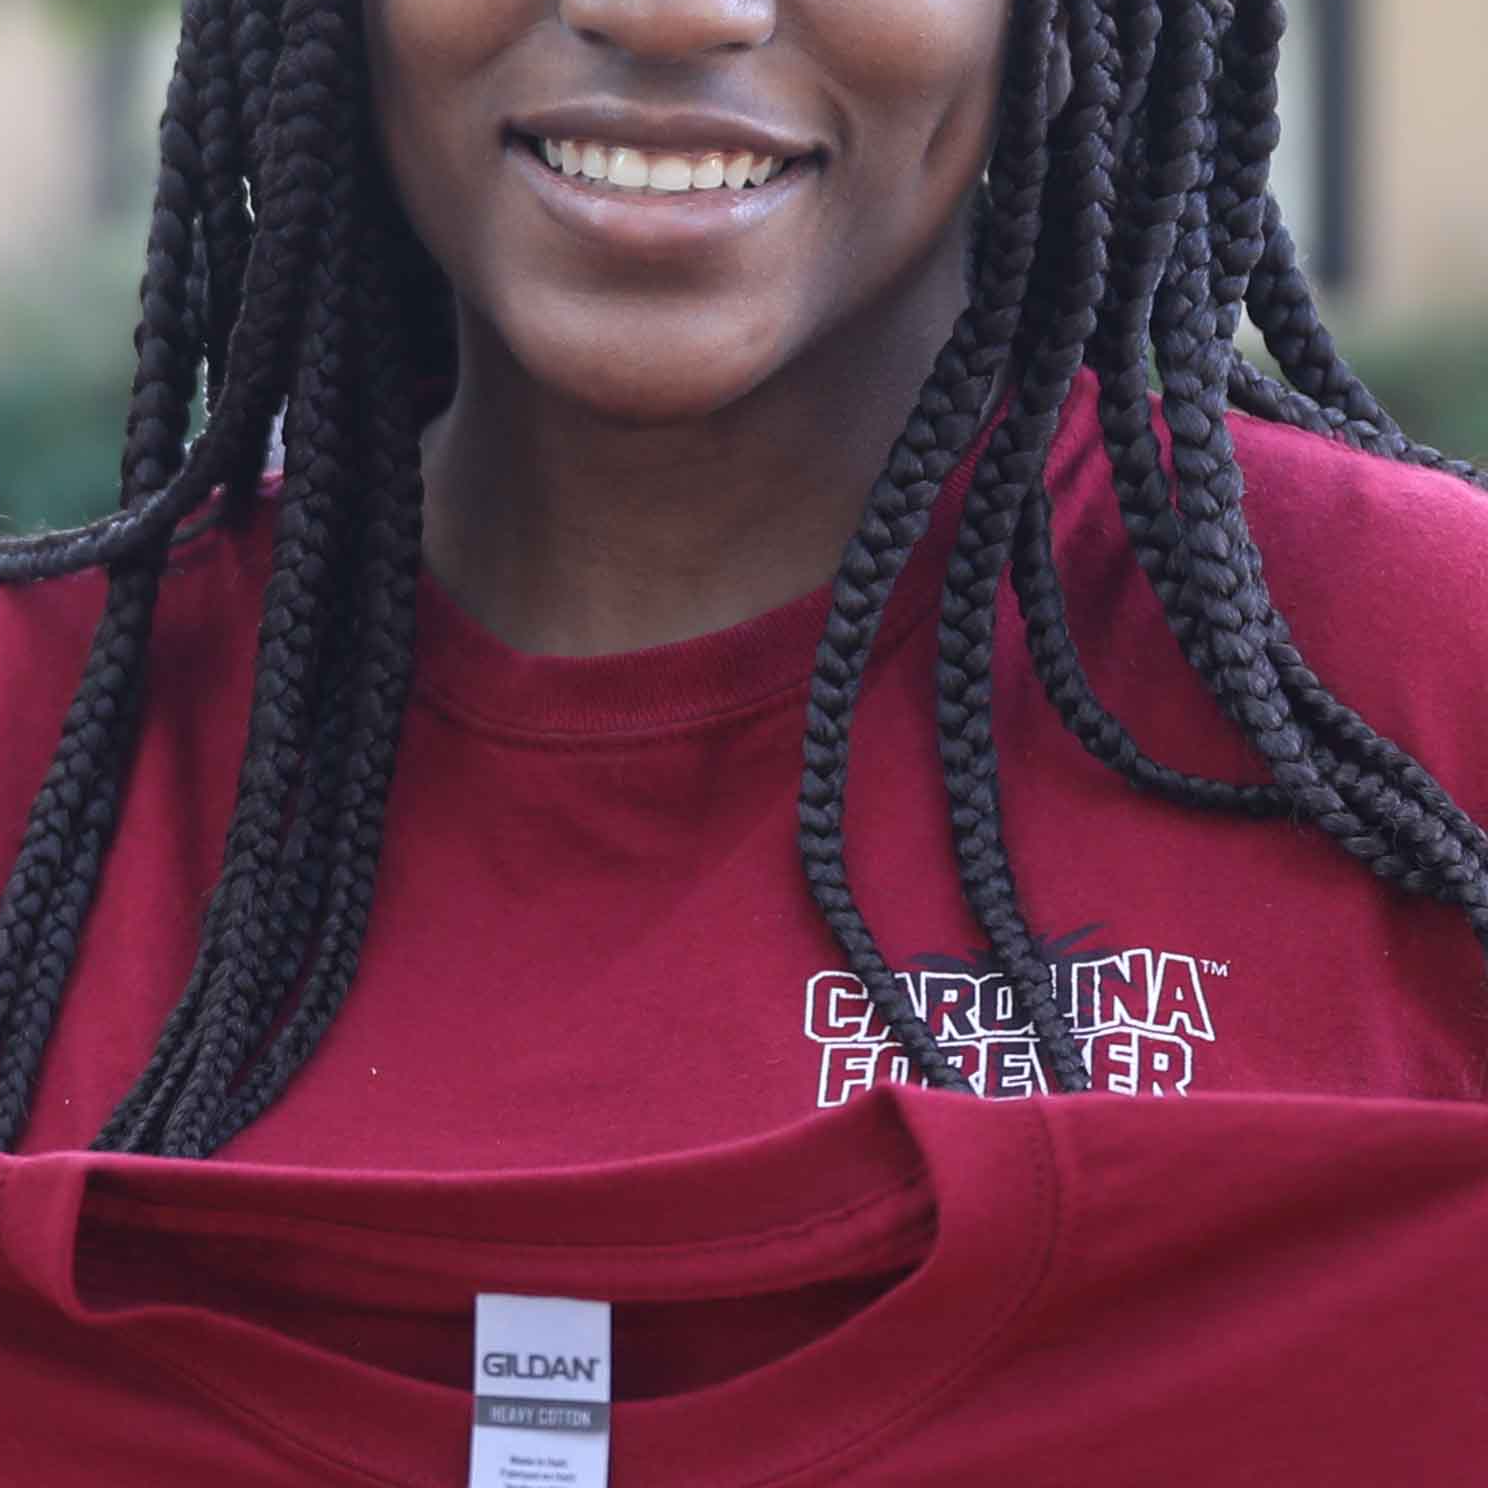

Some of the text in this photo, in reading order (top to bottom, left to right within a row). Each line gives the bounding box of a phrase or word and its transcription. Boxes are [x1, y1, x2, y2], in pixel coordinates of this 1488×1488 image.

[482, 1352, 595, 1383] GILDAN
[489, 1405, 591, 1427] HEAVY COTTON
